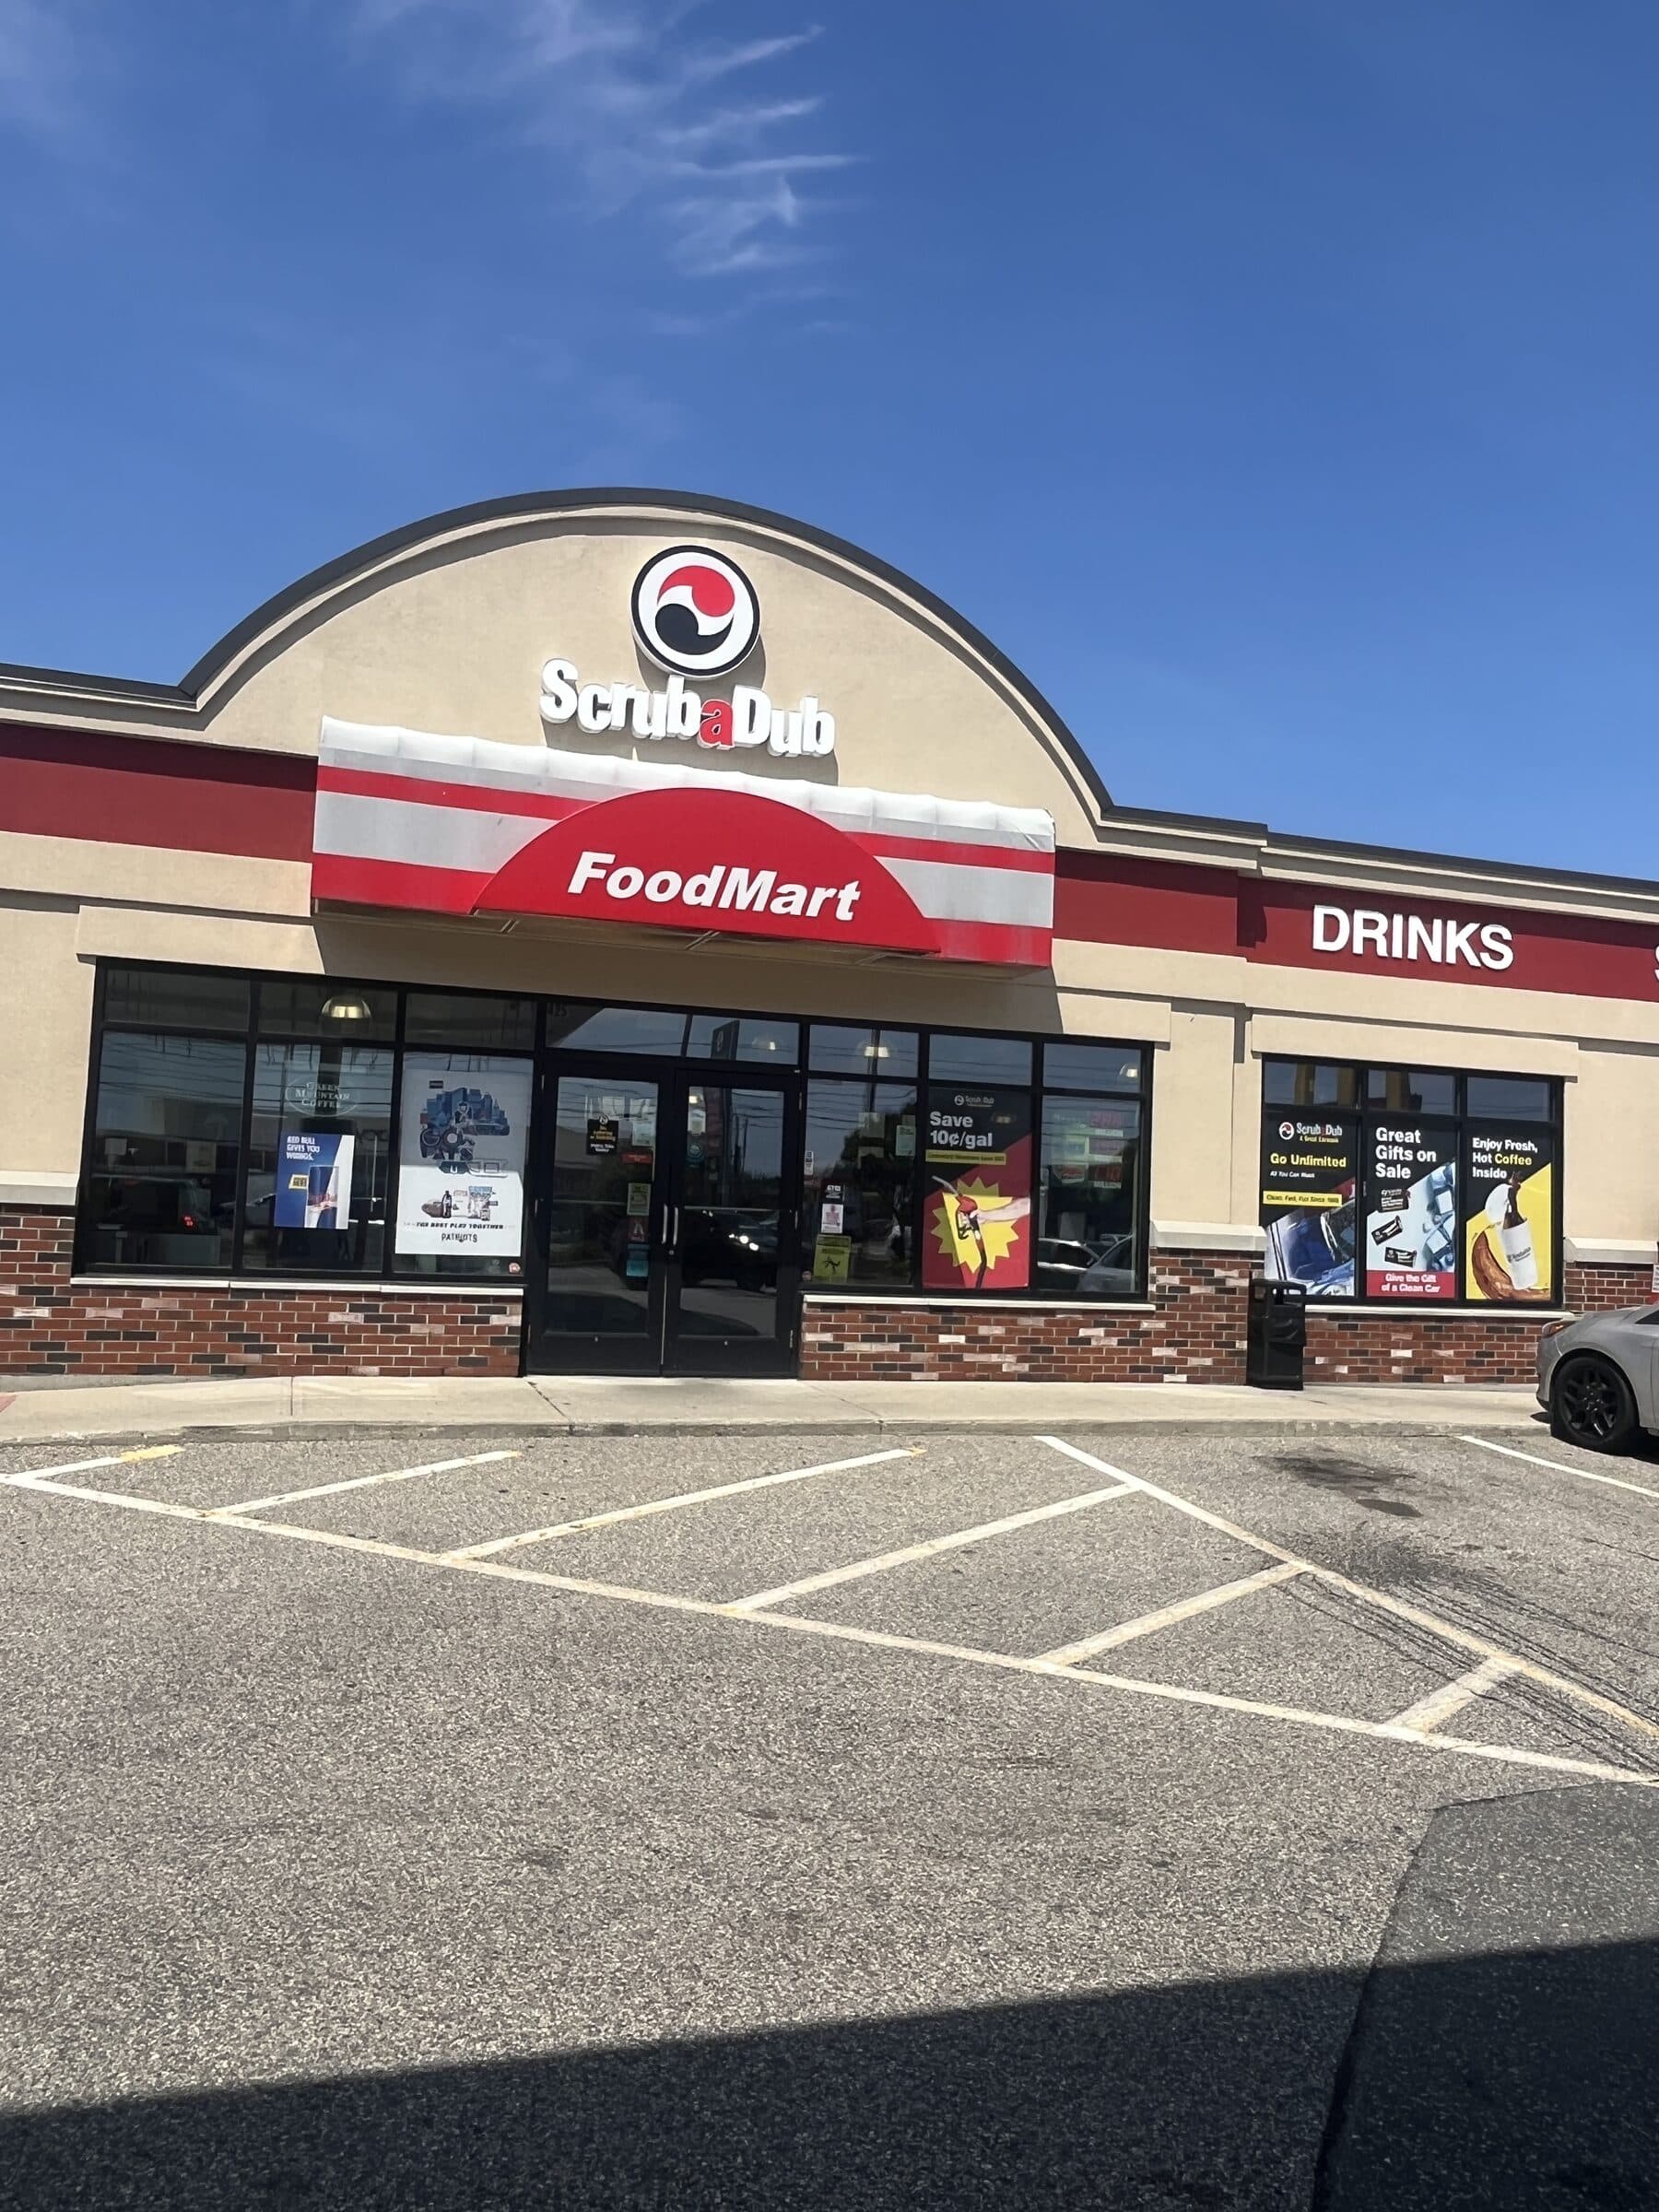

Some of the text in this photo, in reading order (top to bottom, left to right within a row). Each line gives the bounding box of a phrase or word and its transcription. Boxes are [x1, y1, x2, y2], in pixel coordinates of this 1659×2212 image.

[540, 658, 835, 758] ScrubaDub
[568, 851, 861, 921] FoodMart
[1312, 904, 1514, 971] DRINKS
[929, 1111, 973, 1128] Save
[929, 1130, 993, 1149] 10¢/gal
[1375, 1126, 1421, 1144] Great
[1375, 1144, 1437, 1162] Gifts on
[1472, 1137, 1538, 1154] Enjoy Fresh,
[1270, 1153, 1347, 1168] Go Unlimited
[1472, 1151, 1533, 1166] Hot Coffee
[1375, 1162, 1412, 1179] Sale
[1472, 1166, 1508, 1179] Inside
[1385, 1273, 1405, 1282] Give
[1406, 1274, 1419, 1282] the
[1381, 1283, 1391, 1292] of
[1399, 1283, 1424, 1292] Clean
[1425, 1284, 1441, 1293] Car
